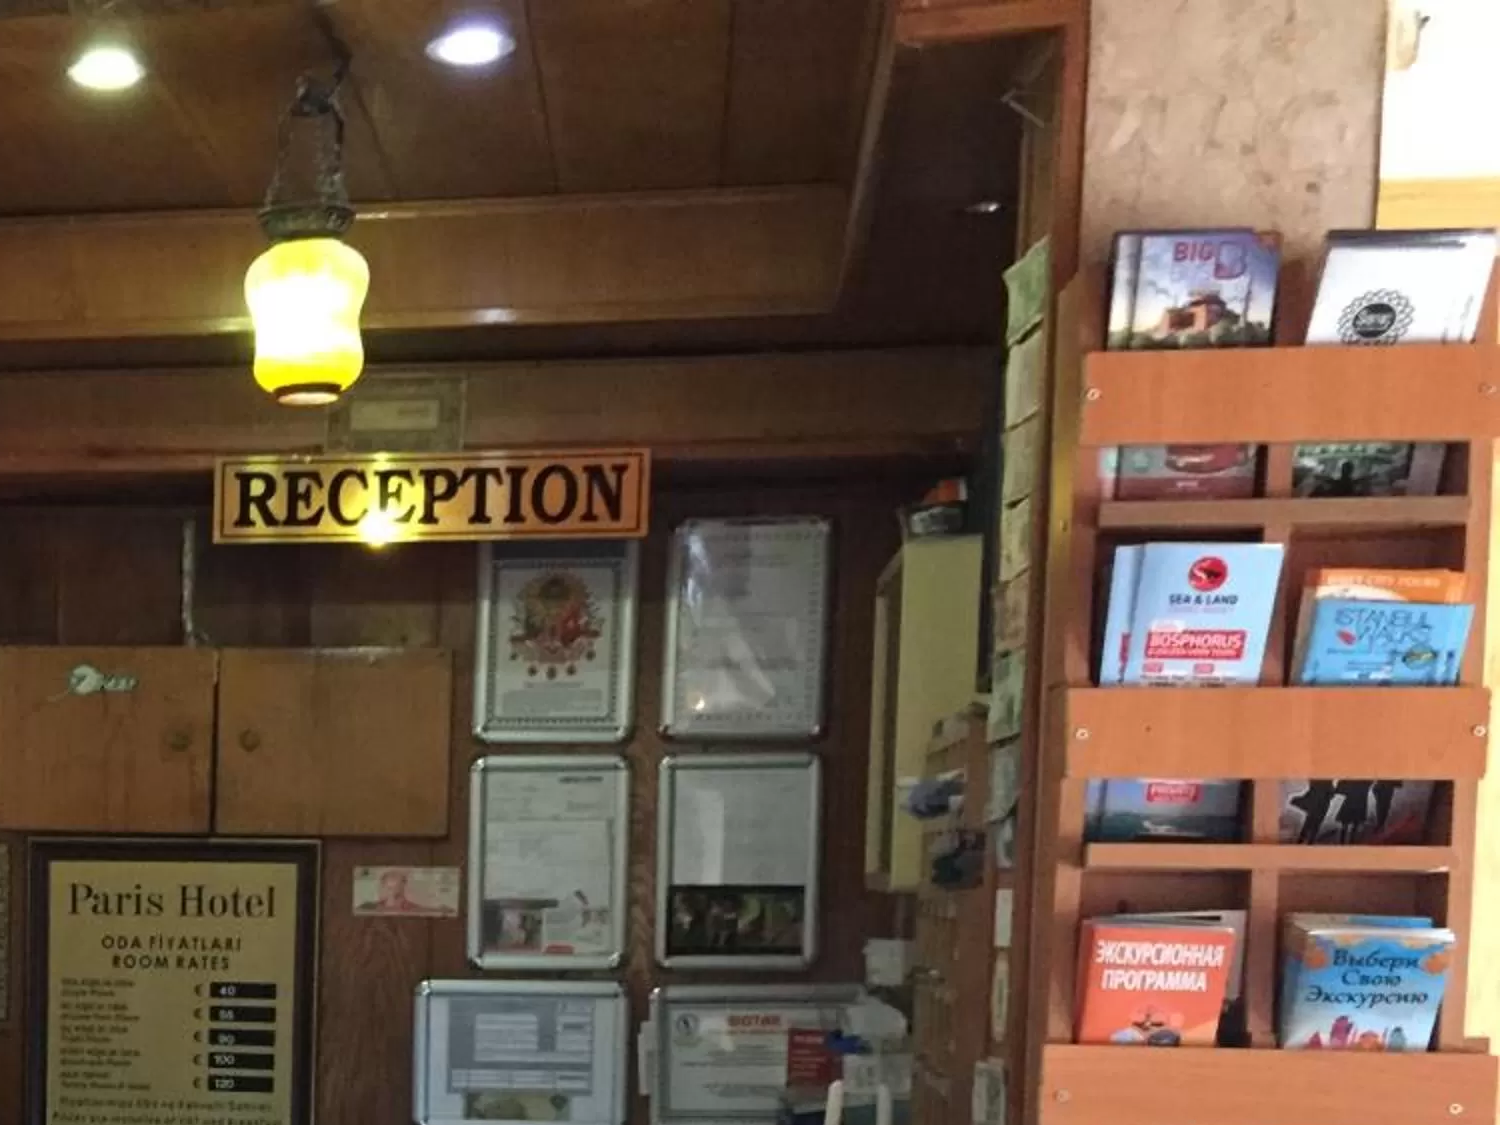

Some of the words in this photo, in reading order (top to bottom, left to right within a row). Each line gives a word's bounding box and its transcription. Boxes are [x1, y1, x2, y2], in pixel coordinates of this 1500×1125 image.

[234, 463, 629, 528] RECEPTION
[1169, 594, 1192, 605] SEA
[1205, 595, 1238, 605] LAND
[1150, 633, 1242, 649] BOSPHORUS
[68, 882, 164, 916] Paris
[179, 883, 276, 918] Hotel
[101, 935, 142, 951] ODA
[1095, 939, 1225, 967] ЭКСКУРСИОННАЯ
[112, 955, 169, 970] ROOM
[176, 956, 230, 971] RATES
[1333, 947, 1420, 973] Выбери
[1101, 968, 1208, 992] ПРОГРАММА
[1341, 968, 1402, 987] Свою
[1304, 984, 1429, 1008] Экскурсию
